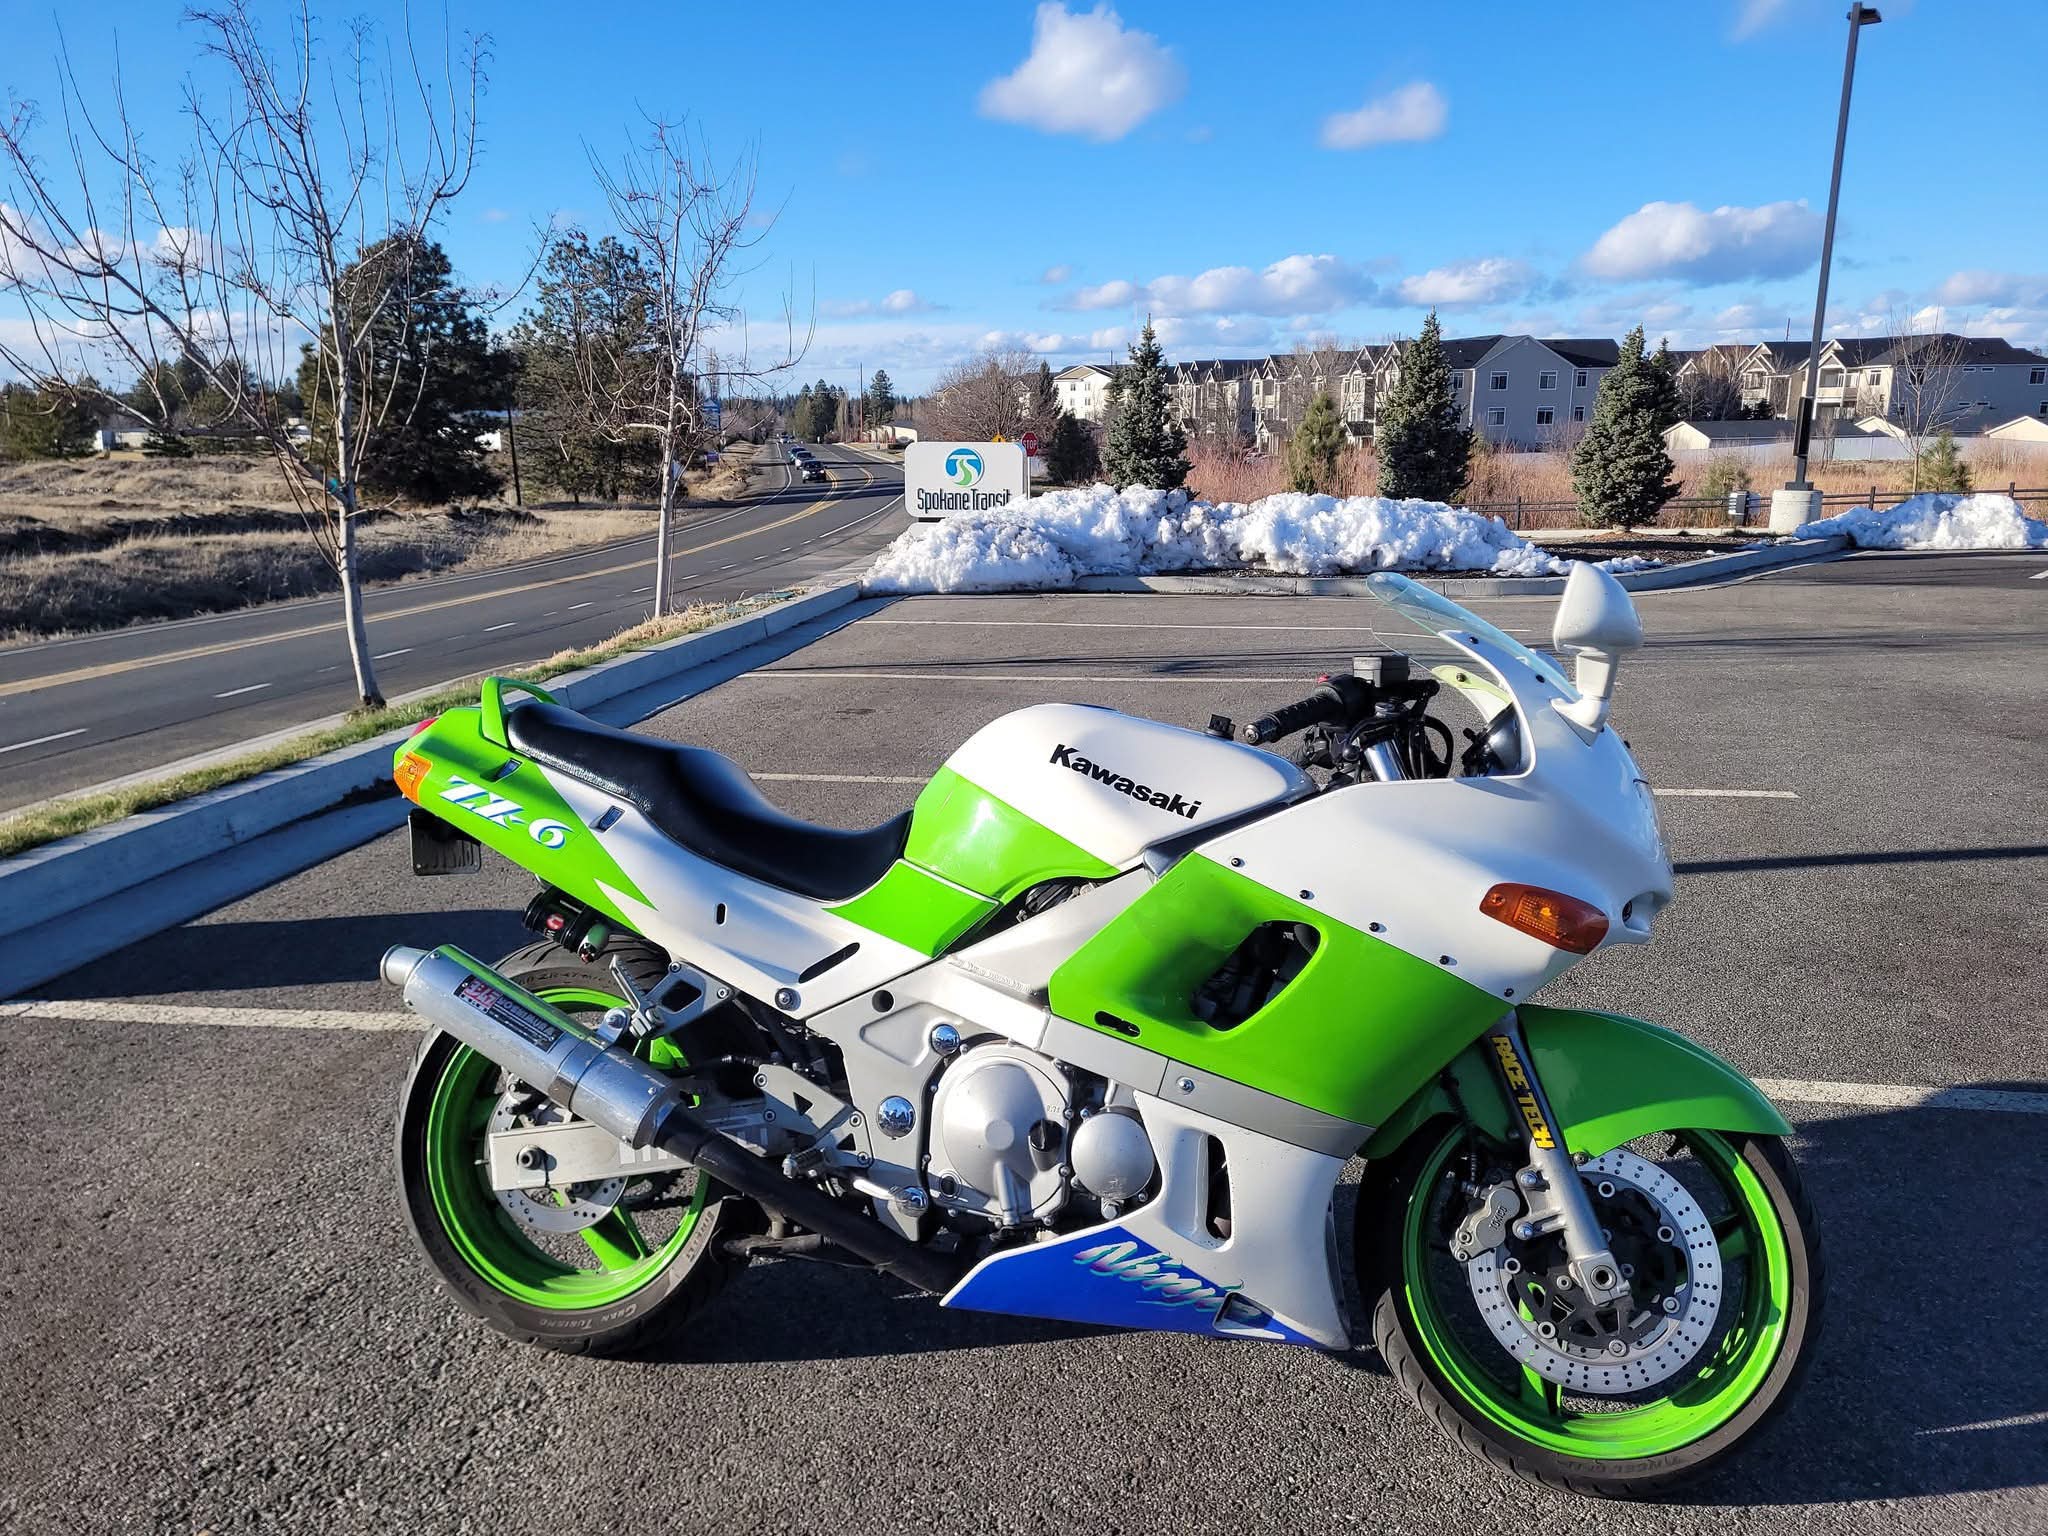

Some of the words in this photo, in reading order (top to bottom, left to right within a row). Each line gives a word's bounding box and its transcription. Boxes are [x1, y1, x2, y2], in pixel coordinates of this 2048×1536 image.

[1022, 439, 1037, 449] STOP
[917, 488, 969, 514] Spokane
[971, 489, 1012, 510] Transit
[1049, 743, 1202, 820] Kawasaki
[496, 996, 555, 1035] YOSHIMURA
[1490, 1036, 1531, 1092] RACE
[1517, 1091, 1556, 1149] TECH
[1073, 1240, 1262, 1318] Ninja
